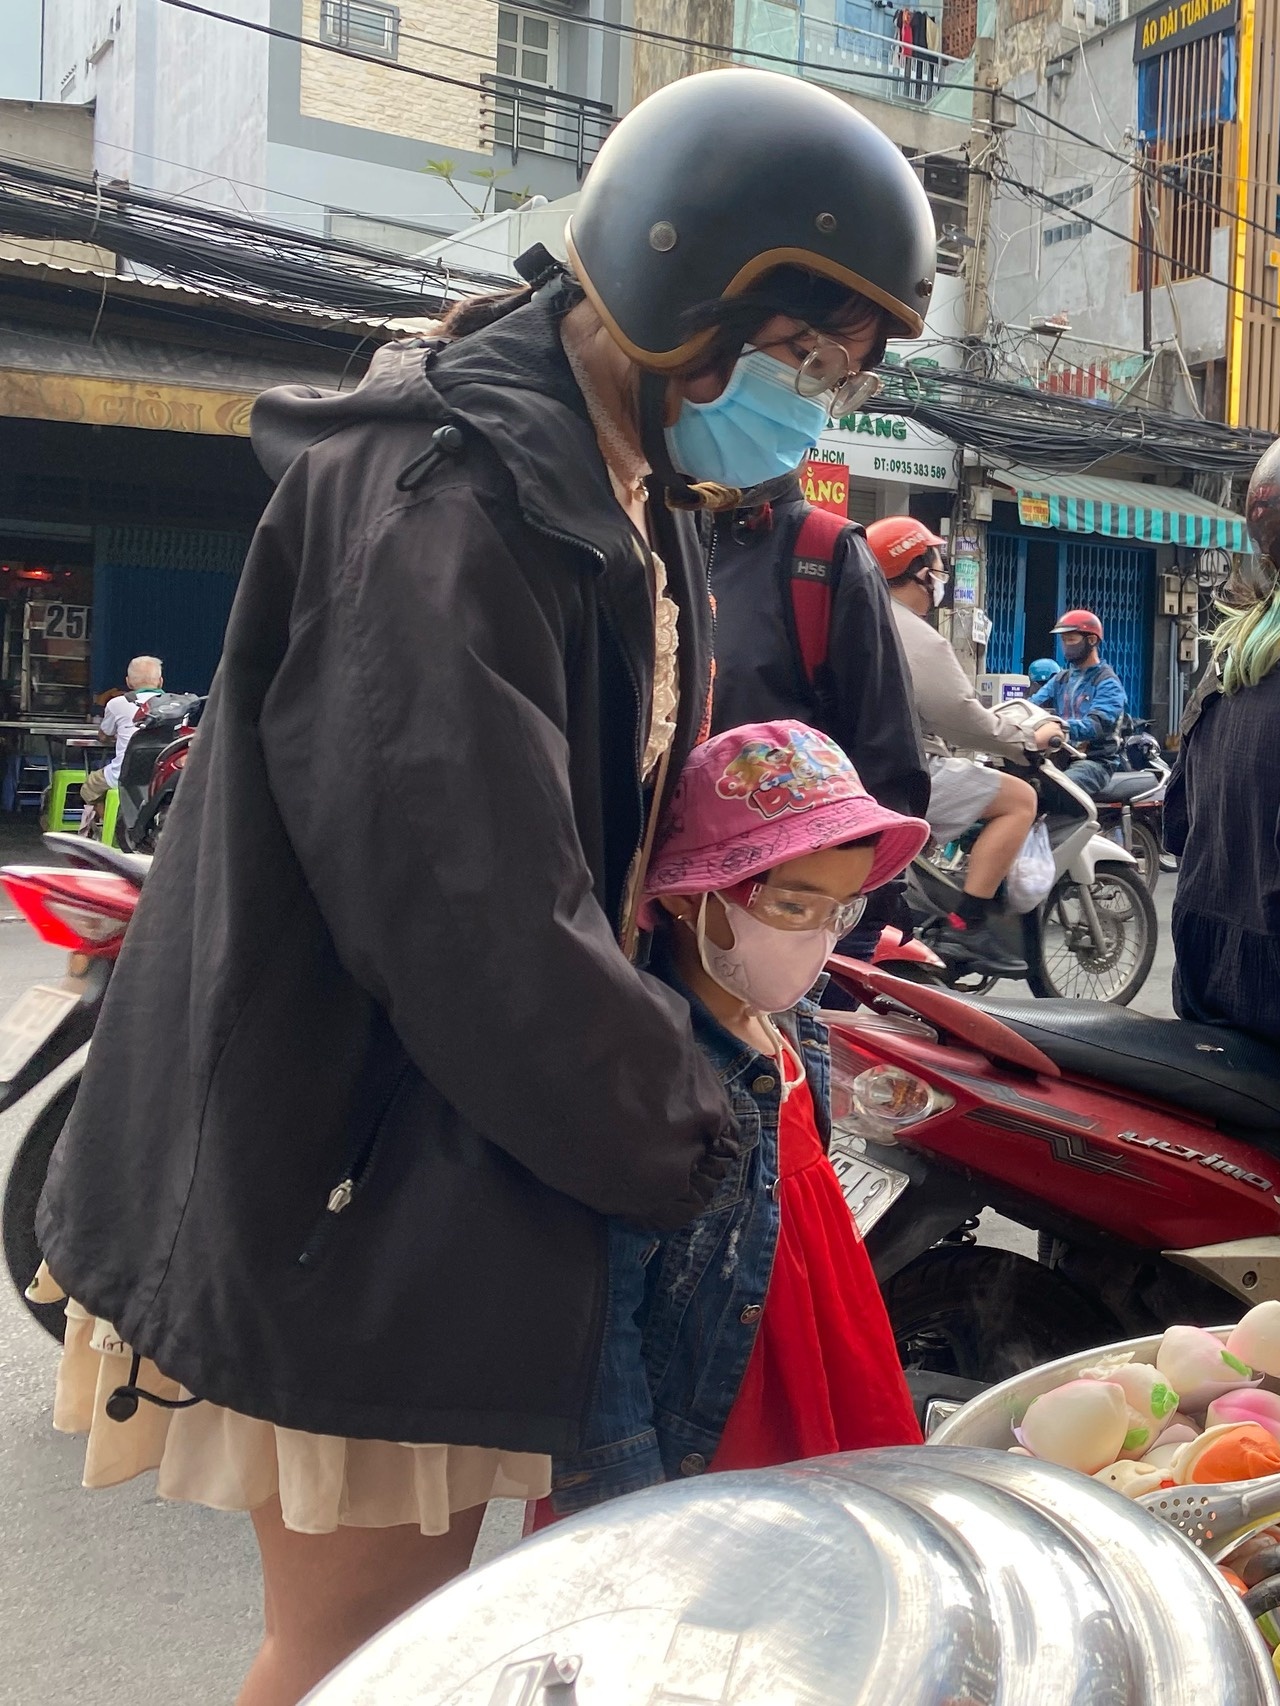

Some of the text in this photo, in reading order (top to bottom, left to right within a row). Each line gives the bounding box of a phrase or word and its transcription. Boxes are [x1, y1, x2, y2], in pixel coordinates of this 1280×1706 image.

[1142, 17, 1158, 50] ÁO
[1160, 6, 1178, 41] DÀI
[914, 462, 929, 477] 383
[930, 465, 947, 480] 589
[45, 605, 91, 640] 25
